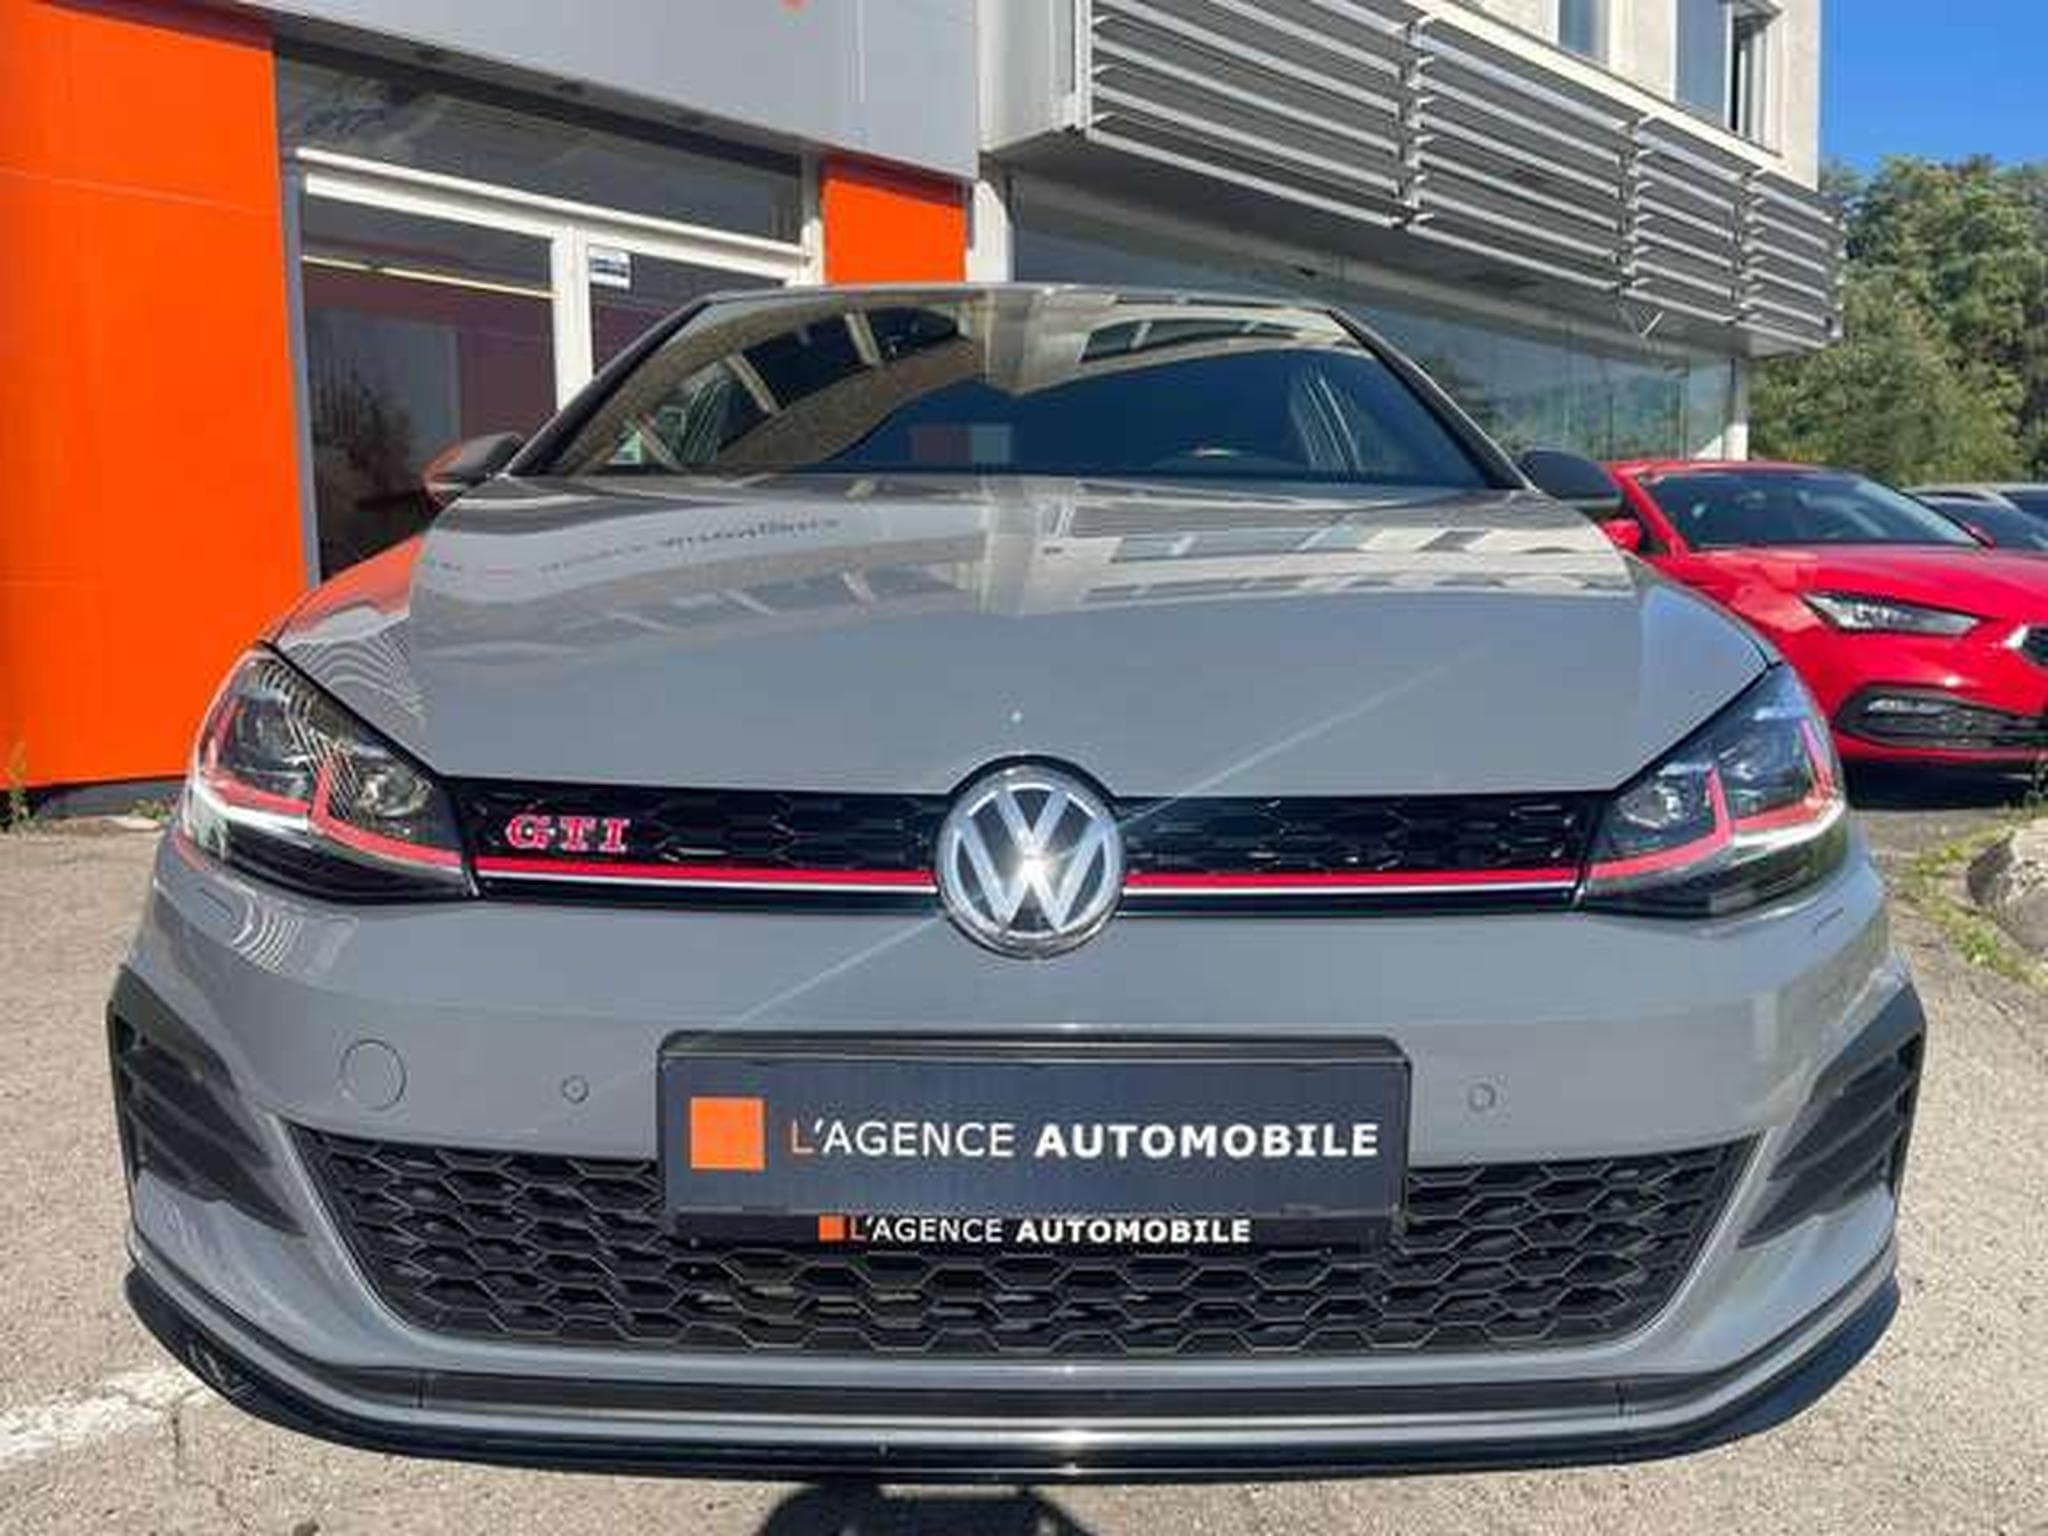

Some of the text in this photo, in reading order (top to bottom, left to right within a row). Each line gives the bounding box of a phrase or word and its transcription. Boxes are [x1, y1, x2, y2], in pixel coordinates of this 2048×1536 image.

[503, 814, 632, 853] GTI
[953, 783, 1113, 938] VW
[789, 1118, 1380, 1160] L'AGENCE AUTOMOBILE
[849, 1216, 1253, 1245] L'AGENCE AUTOMOBILE
